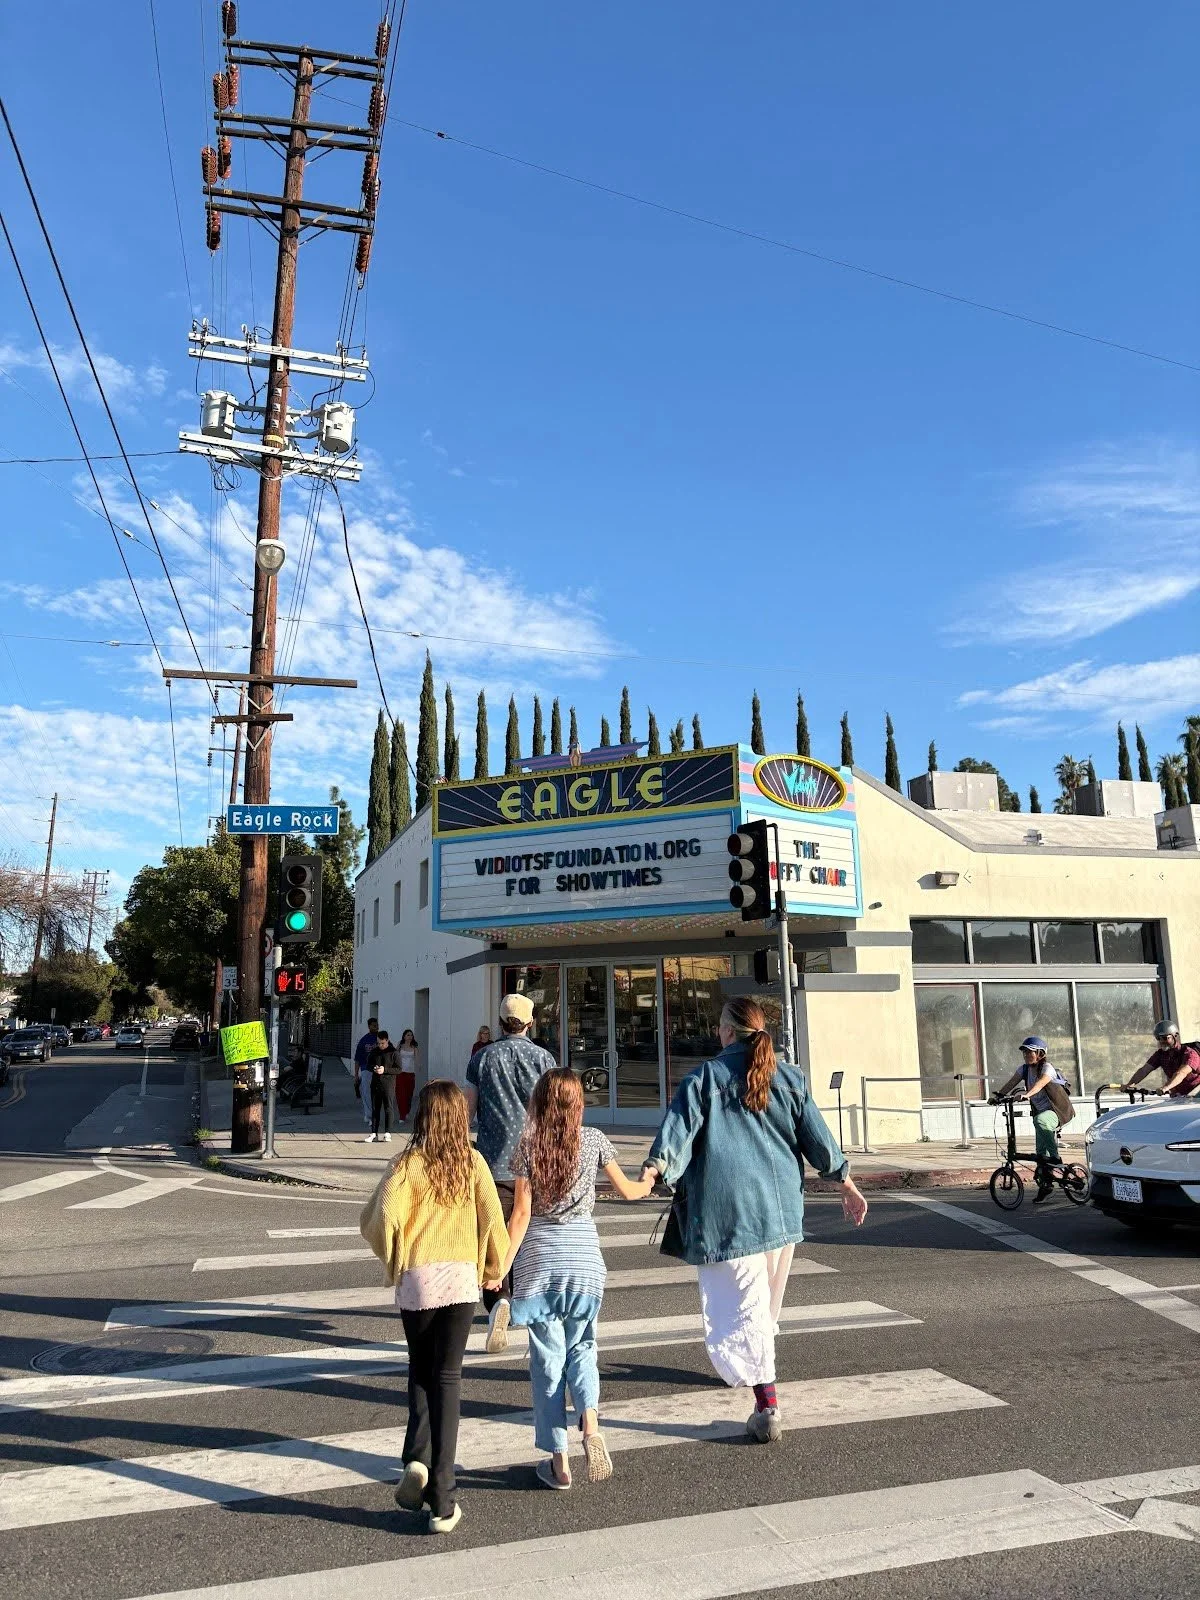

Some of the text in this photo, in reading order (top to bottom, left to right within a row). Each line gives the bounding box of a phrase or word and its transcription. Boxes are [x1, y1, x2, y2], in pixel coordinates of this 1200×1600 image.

[497, 767, 665, 820] EAGLE
[232, 811, 333, 831] Eagle Rock
[474, 838, 701, 876] VIDIOTSFOUNDATION.ORG
[793, 839, 821, 860] THE
[505, 867, 663, 897] FOR SHOWTIMES
[809, 866, 847, 887] CHAIR
[295, 973, 305, 991] 15
